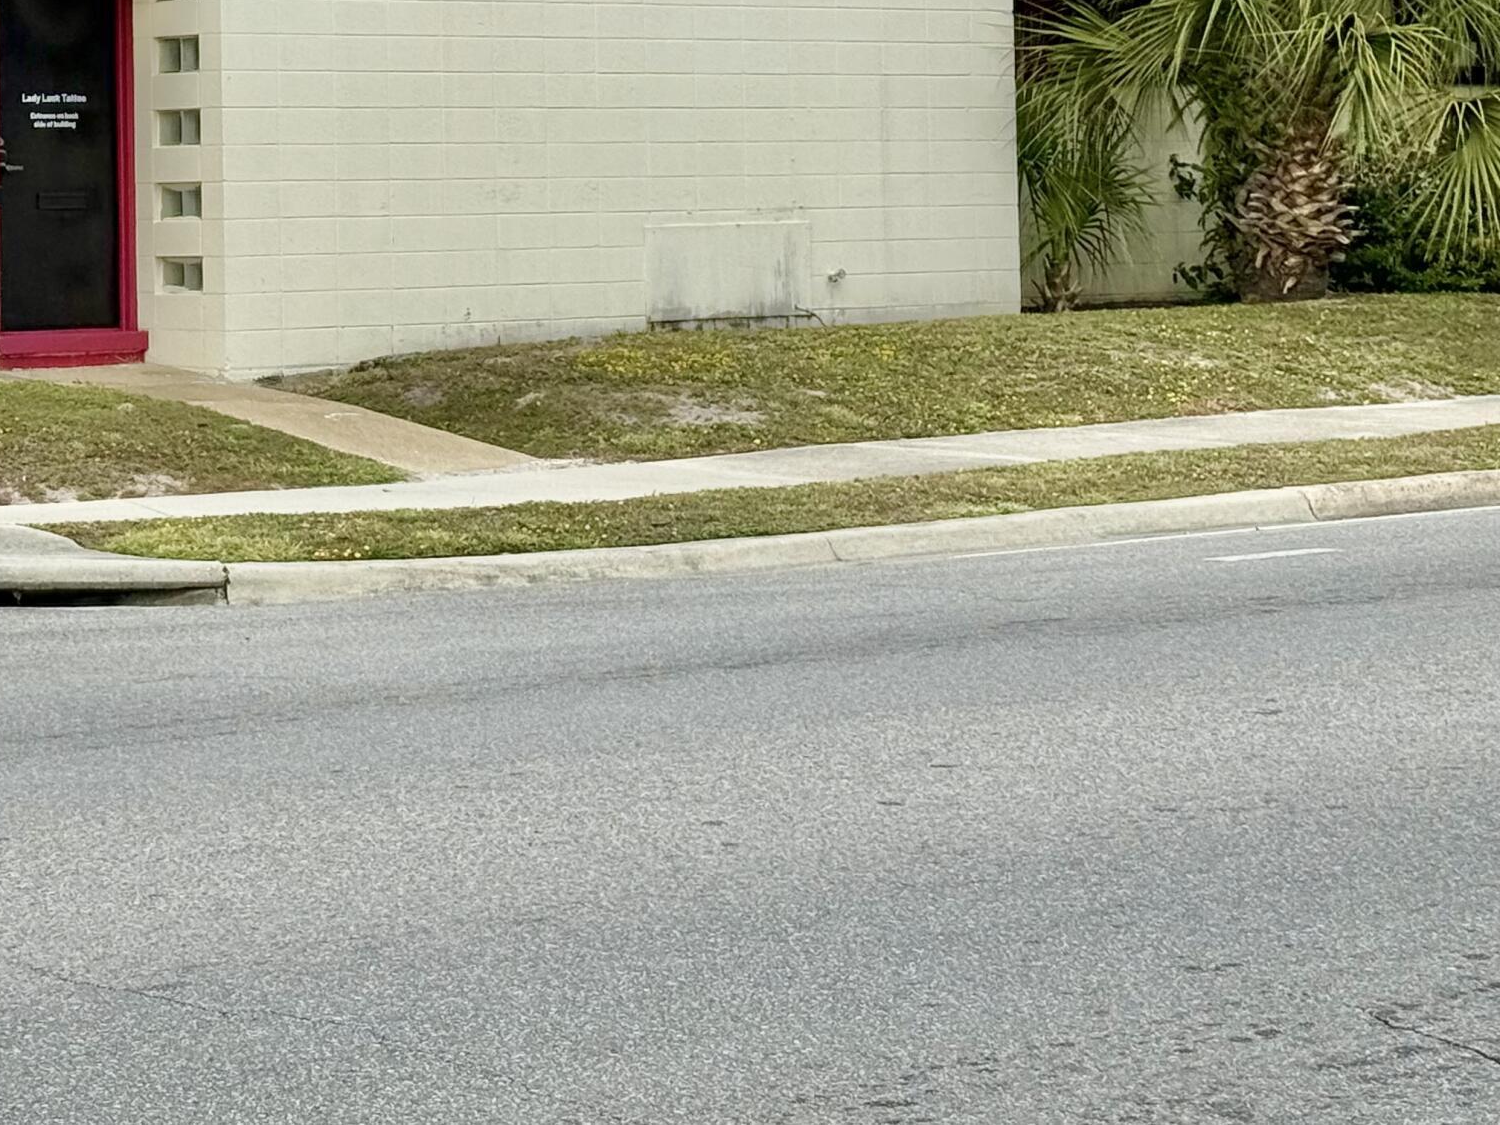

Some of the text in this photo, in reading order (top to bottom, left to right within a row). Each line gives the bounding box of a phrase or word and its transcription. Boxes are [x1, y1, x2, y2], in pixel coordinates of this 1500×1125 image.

[22, 93, 87, 105] Lady Luck Tattoo
